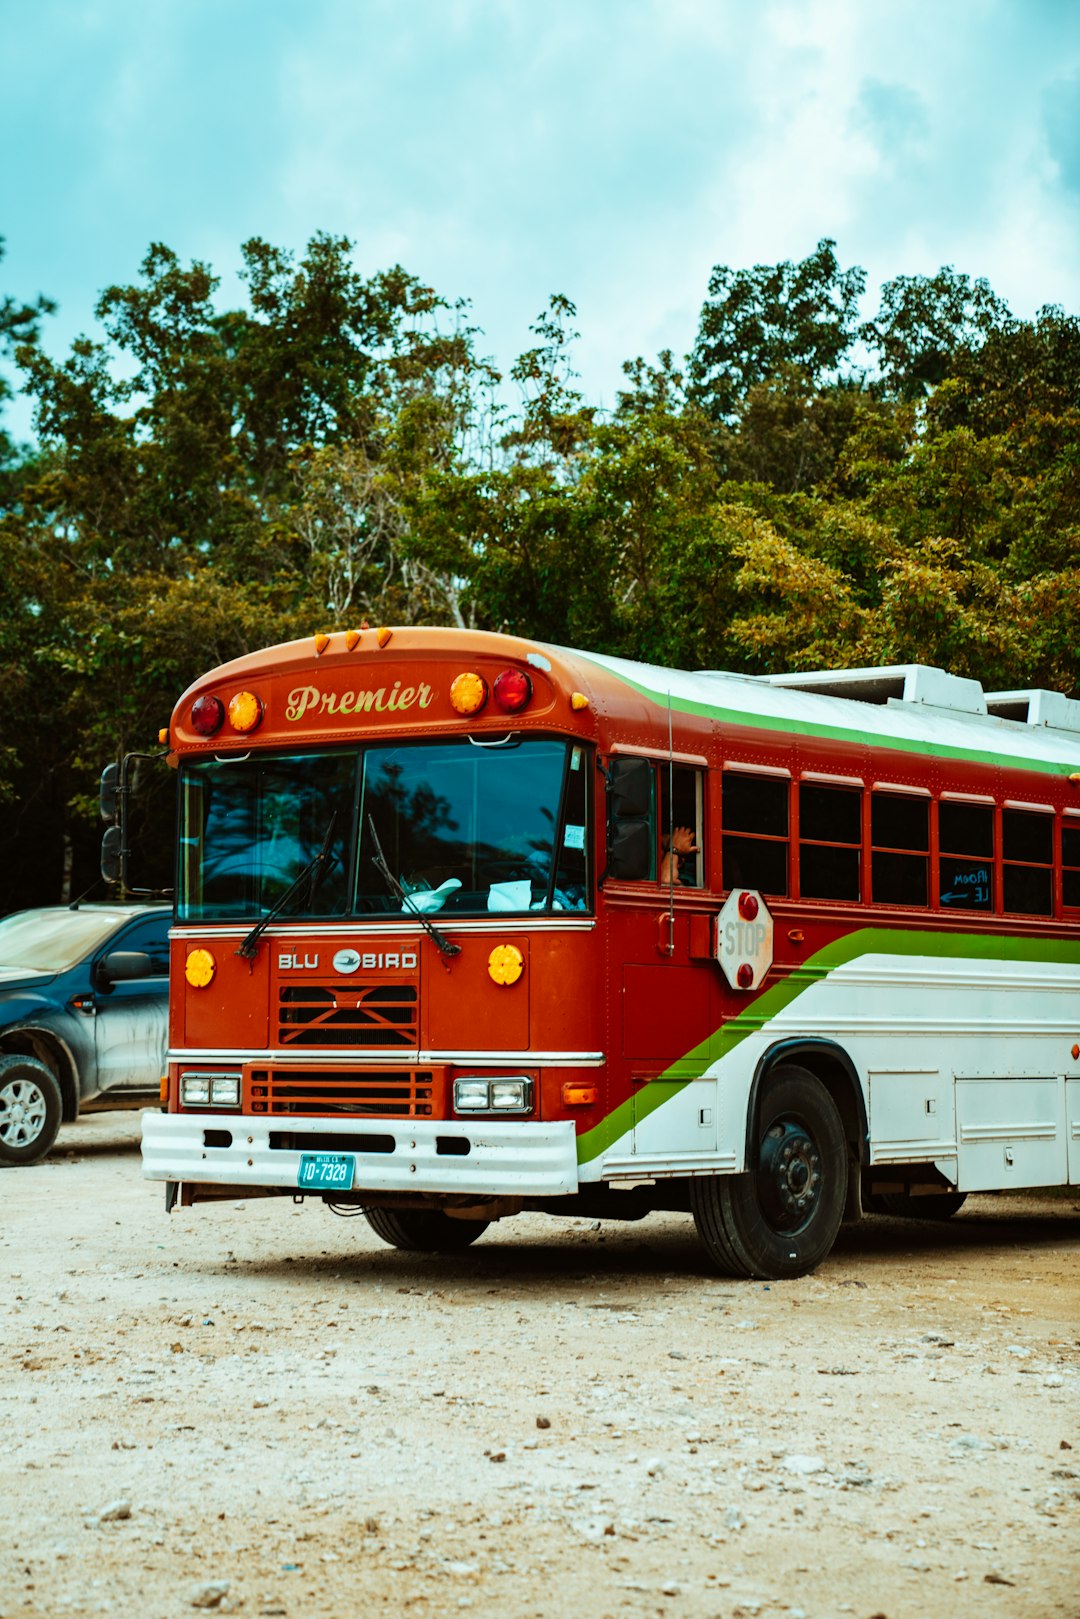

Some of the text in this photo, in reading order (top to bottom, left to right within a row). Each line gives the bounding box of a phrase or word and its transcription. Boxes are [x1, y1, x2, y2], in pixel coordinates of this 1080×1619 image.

[285, 680, 434, 721] Premier
[725, 921, 766, 957] STOP
[278, 953, 417, 969] BLU BIRD
